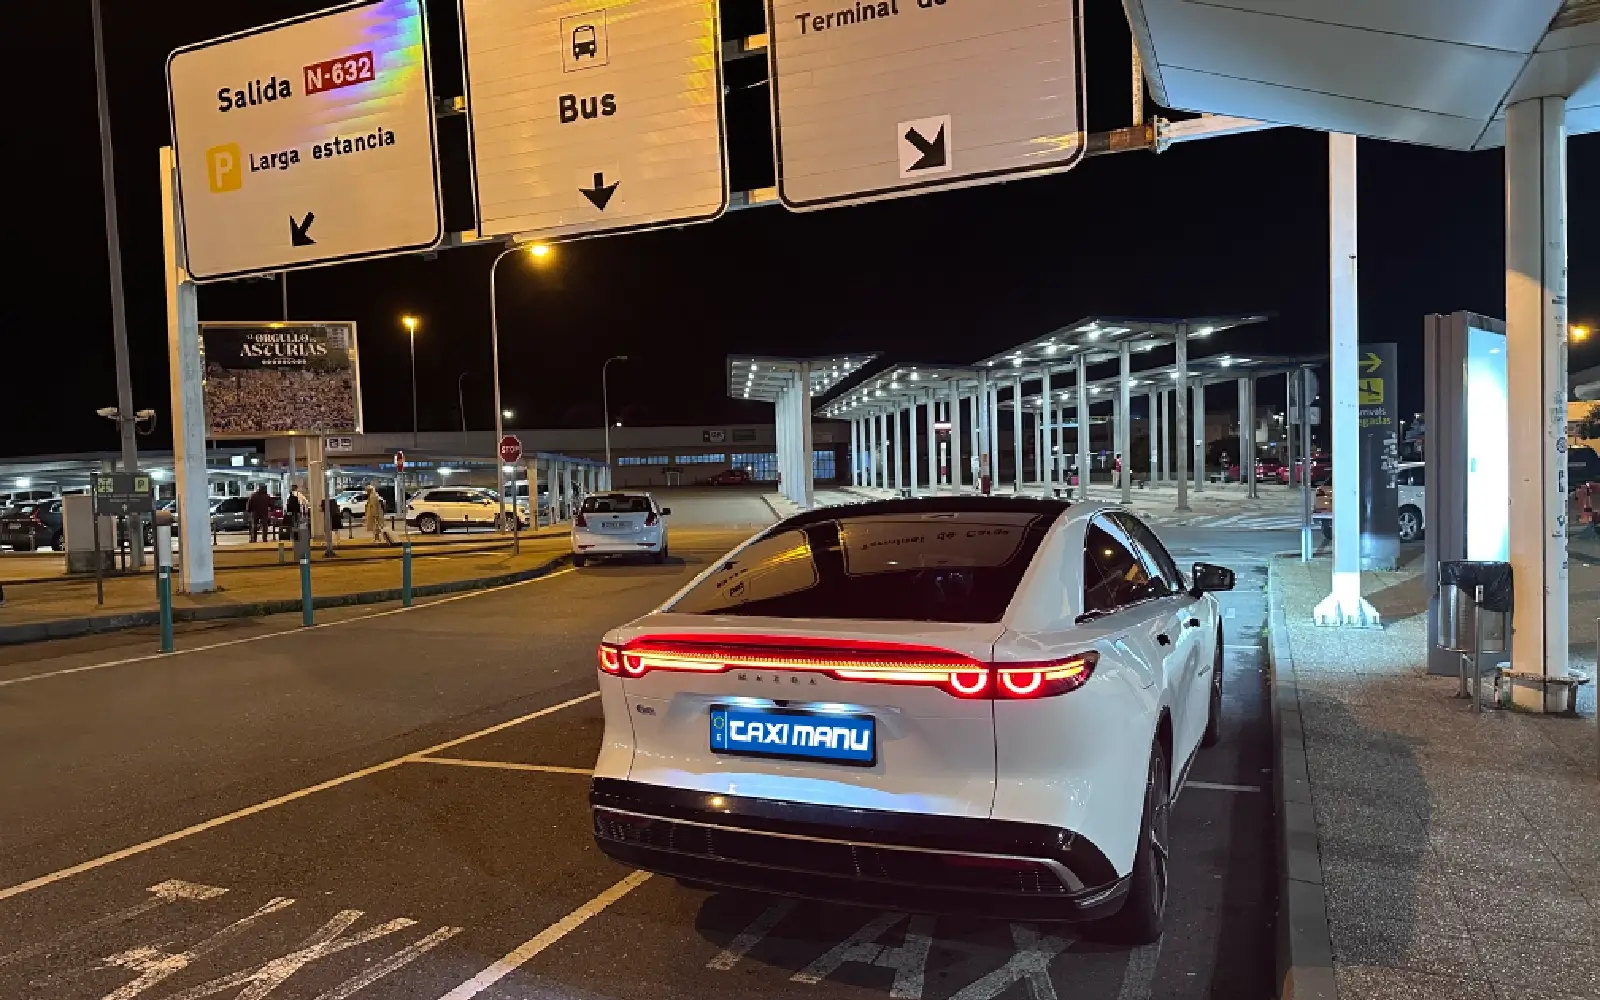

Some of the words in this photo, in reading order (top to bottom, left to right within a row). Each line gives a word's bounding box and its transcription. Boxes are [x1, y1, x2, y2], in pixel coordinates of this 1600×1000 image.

[795, 0, 899, 34] Terminal
[218, 78, 292, 112] Salida
[306, 57, 372, 91] N-632
[558, 90, 617, 123] Bus
[249, 148, 300, 172] Larga
[312, 127, 395, 159] estancia
[240, 342, 327, 357] ASTURIAS
[255, 333, 309, 343] ORGULLO
[501, 445, 520, 454] STOP
